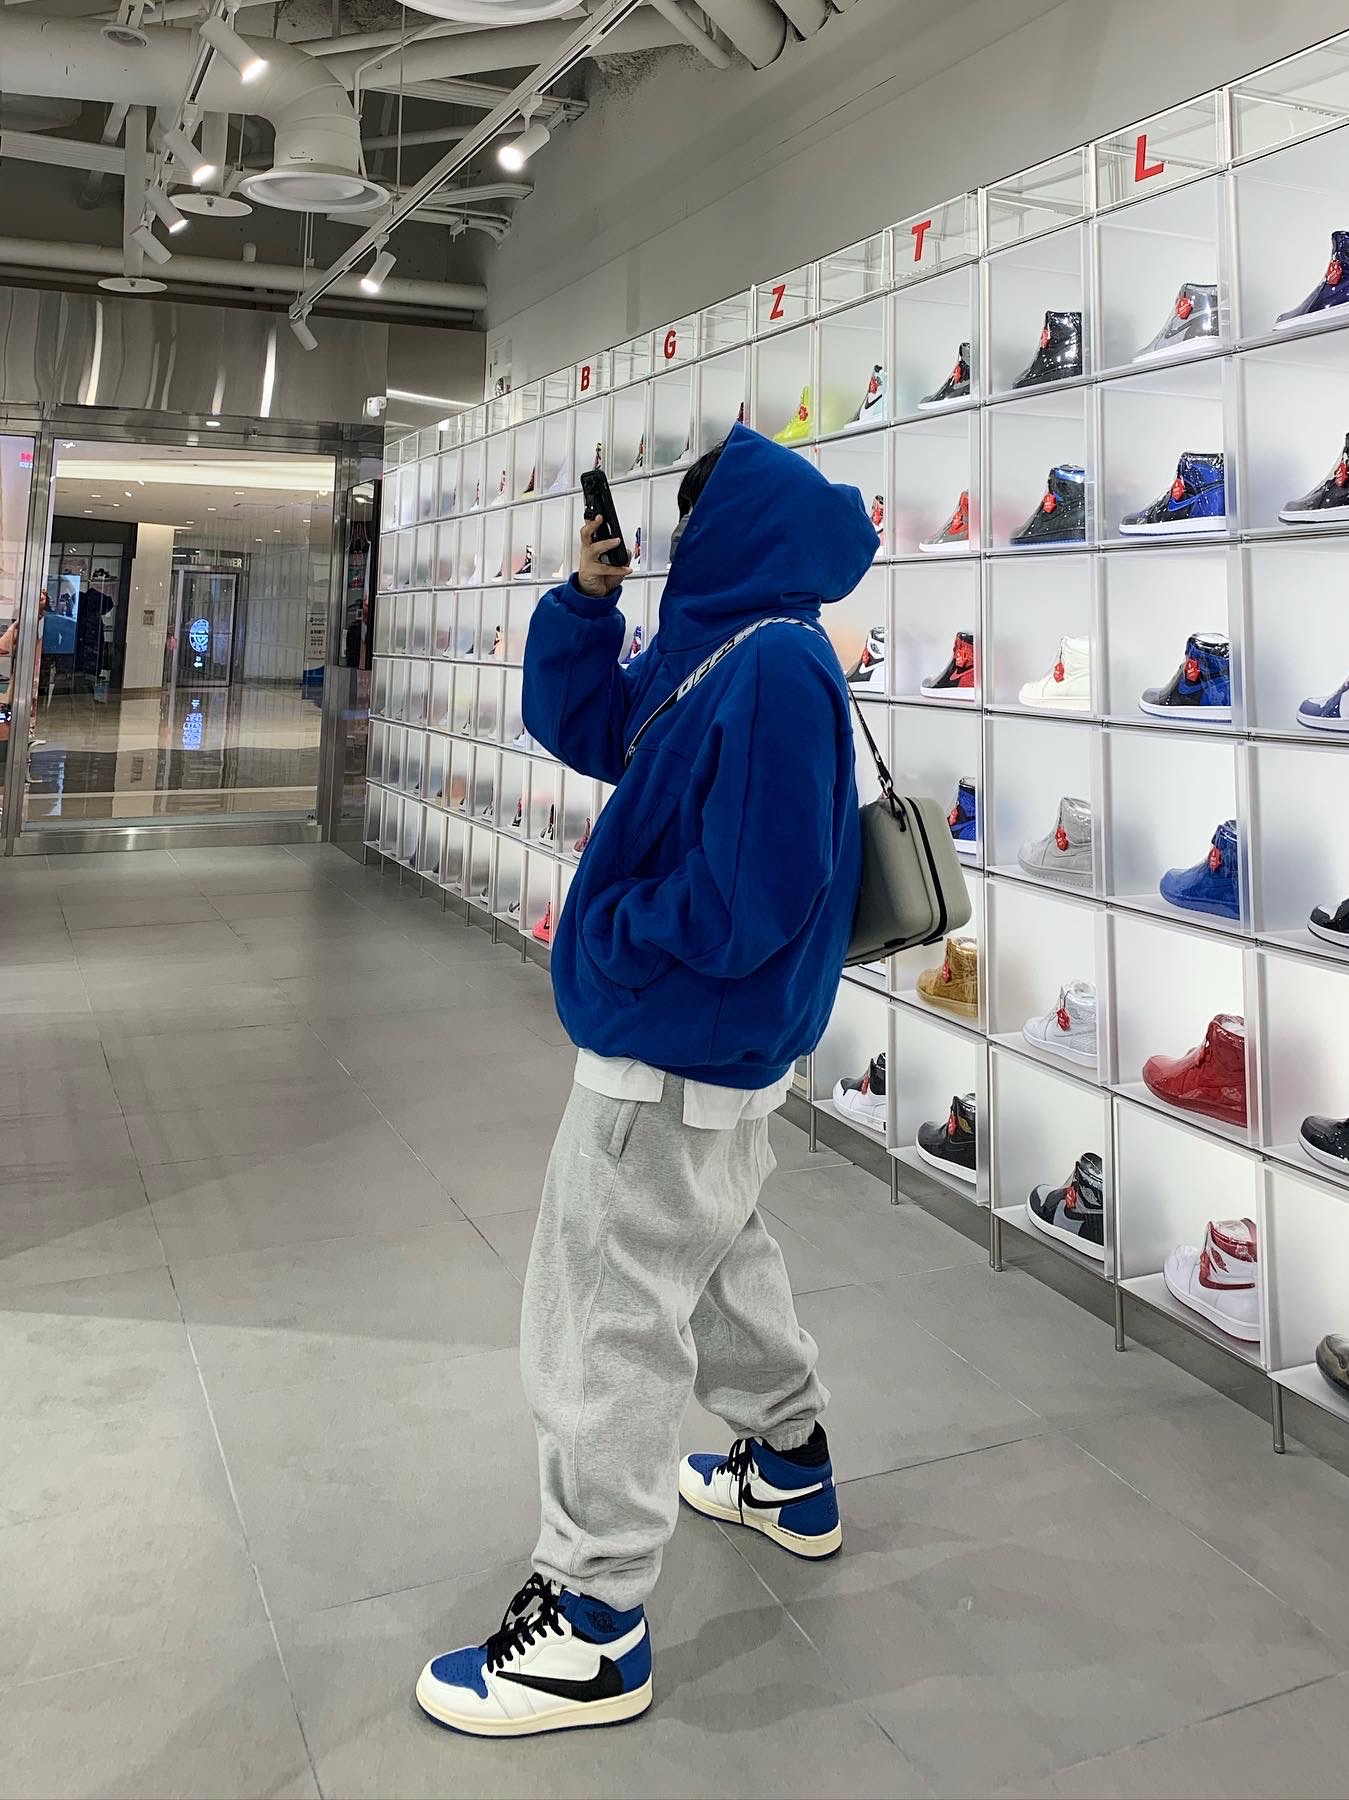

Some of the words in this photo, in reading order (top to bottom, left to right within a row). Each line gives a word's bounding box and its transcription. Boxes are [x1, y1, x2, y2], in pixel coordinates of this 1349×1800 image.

[1135, 134, 1164, 182] L
[912, 219, 931, 261] T
[770, 284, 784, 320] Z
[664, 330, 677, 359] G
[580, 367, 591, 391] B
